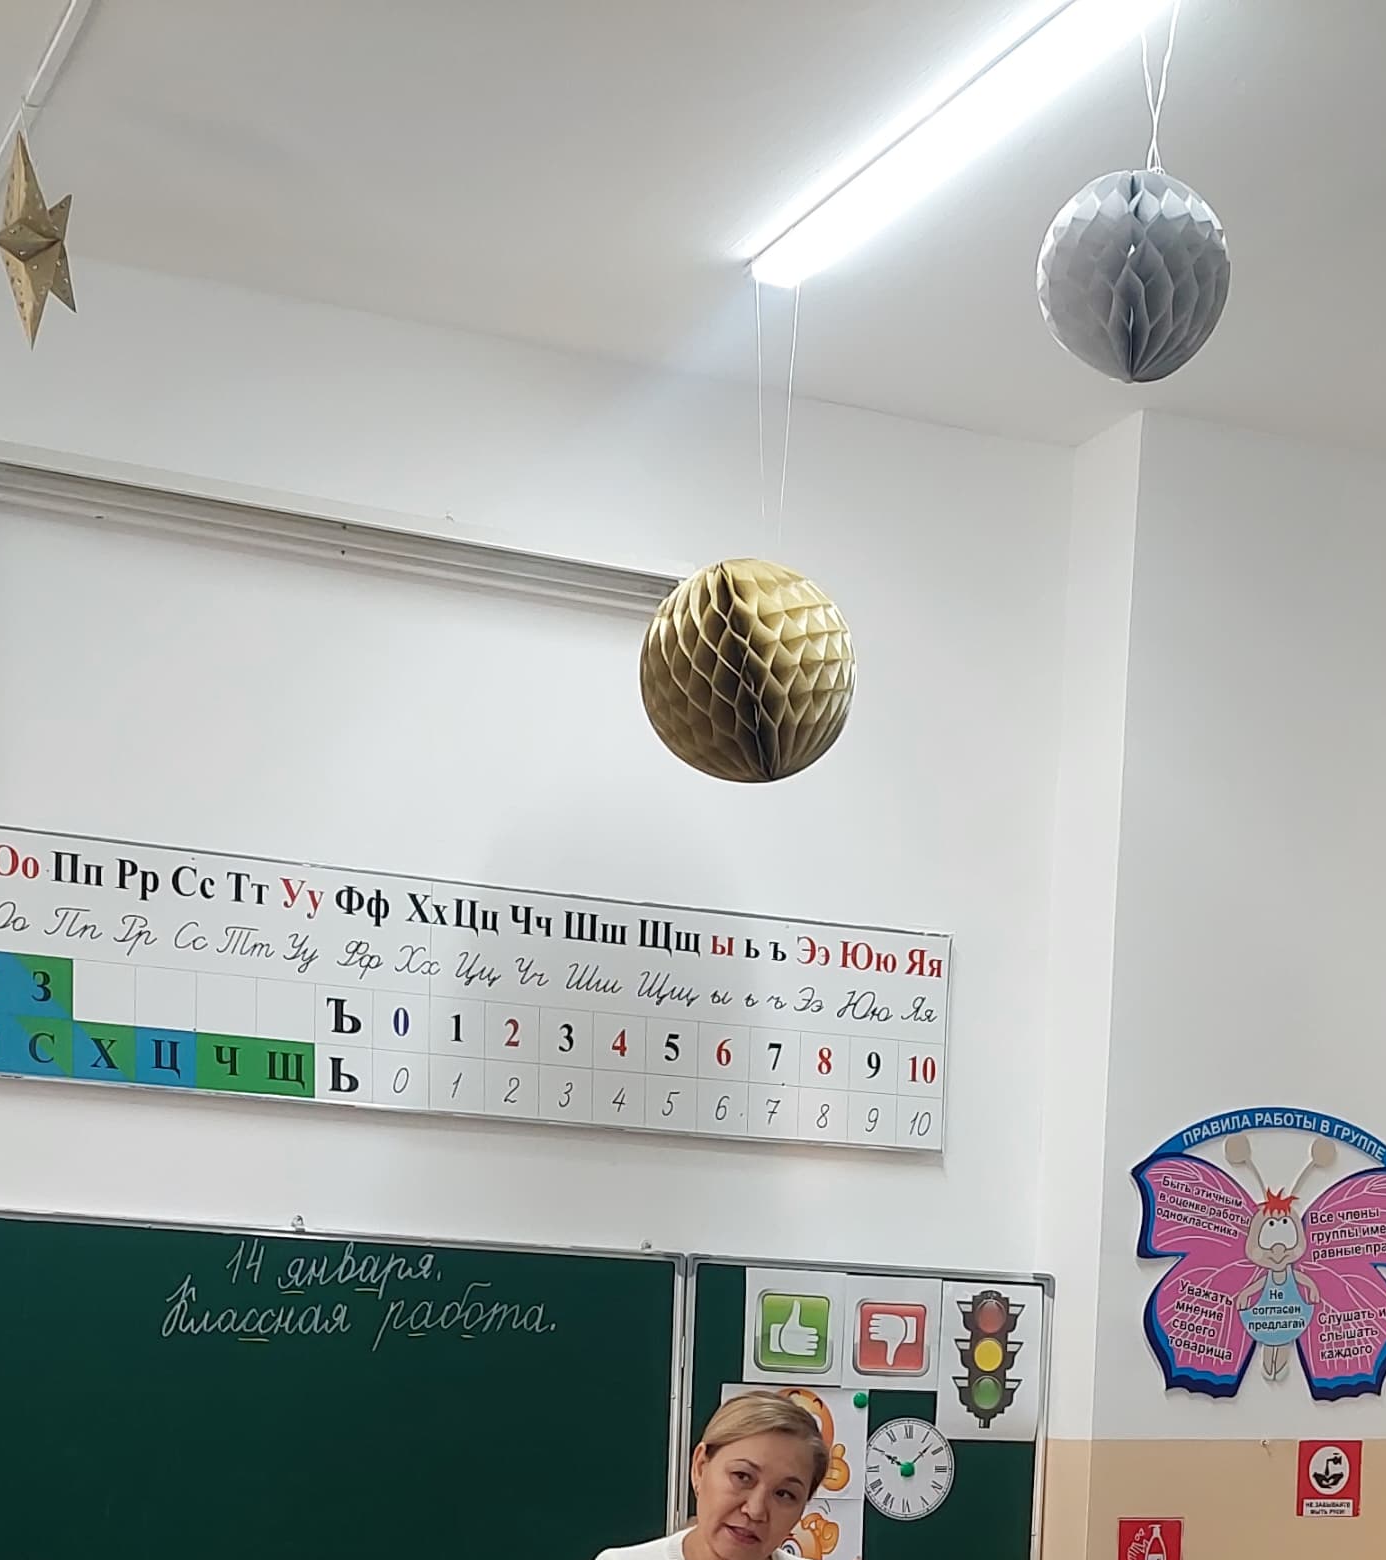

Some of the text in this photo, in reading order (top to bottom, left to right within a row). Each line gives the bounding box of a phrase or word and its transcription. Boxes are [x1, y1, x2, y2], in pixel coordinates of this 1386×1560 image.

[51, 851, 104, 888] Пп
[115, 858, 159, 901] Рр
[171, 865, 215, 900] Сс
[226, 871, 269, 906] Тт
[279, 877, 325, 920] Уу
[335, 885, 390, 927] Фф
[406, 892, 447, 926] Хх
[453, 898, 499, 935] Цц
[509, 903, 552, 939] Чч
[563, 910, 627, 947] Шш
[637, 918, 702, 958] Щщ
[710, 935, 734, 958] ы
[744, 937, 760, 959] ь
[769, 940, 787, 962] ъ
[796, 935, 831, 967] Ээ
[840, 939, 897, 974] Юю
[905, 946, 943, 979] Яя
[392, 1007, 937, 1085] 0 1 2 3 4 5 6 7 8 9 10
[1183, 1113, 1386, 1160] ПРАВИЛА РАБОТЫ В ГРУППЕ
[1163, 1175, 1242, 1207] Быть этичным
[1159, 1193, 1250, 1225] в оценке работы
[1310, 1208, 1379, 1224] Все члены
[1157, 1207, 1238, 1237] одноклассника
[1312, 1228, 1359, 1244] группы
[226, 1237, 263, 1284] 14
[1313, 1245, 1362, 1261] равные
[1179, 1280, 1233, 1306] Уважать
[1270, 1288, 1283, 1300] Не
[162, 1274, 556, 1352] Классная работа.
[1175, 1302, 1223, 1321] мнение
[1253, 1306, 1301, 1315] согласен
[1318, 1308, 1386, 1325] Слушать и
[1172, 1319, 1215, 1338] своего
[1248, 1319, 1305, 1331] предлагай
[1319, 1328, 1378, 1342] слышать
[1168, 1335, 1232, 1361] товарища
[1321, 1345, 1373, 1360] каждого
